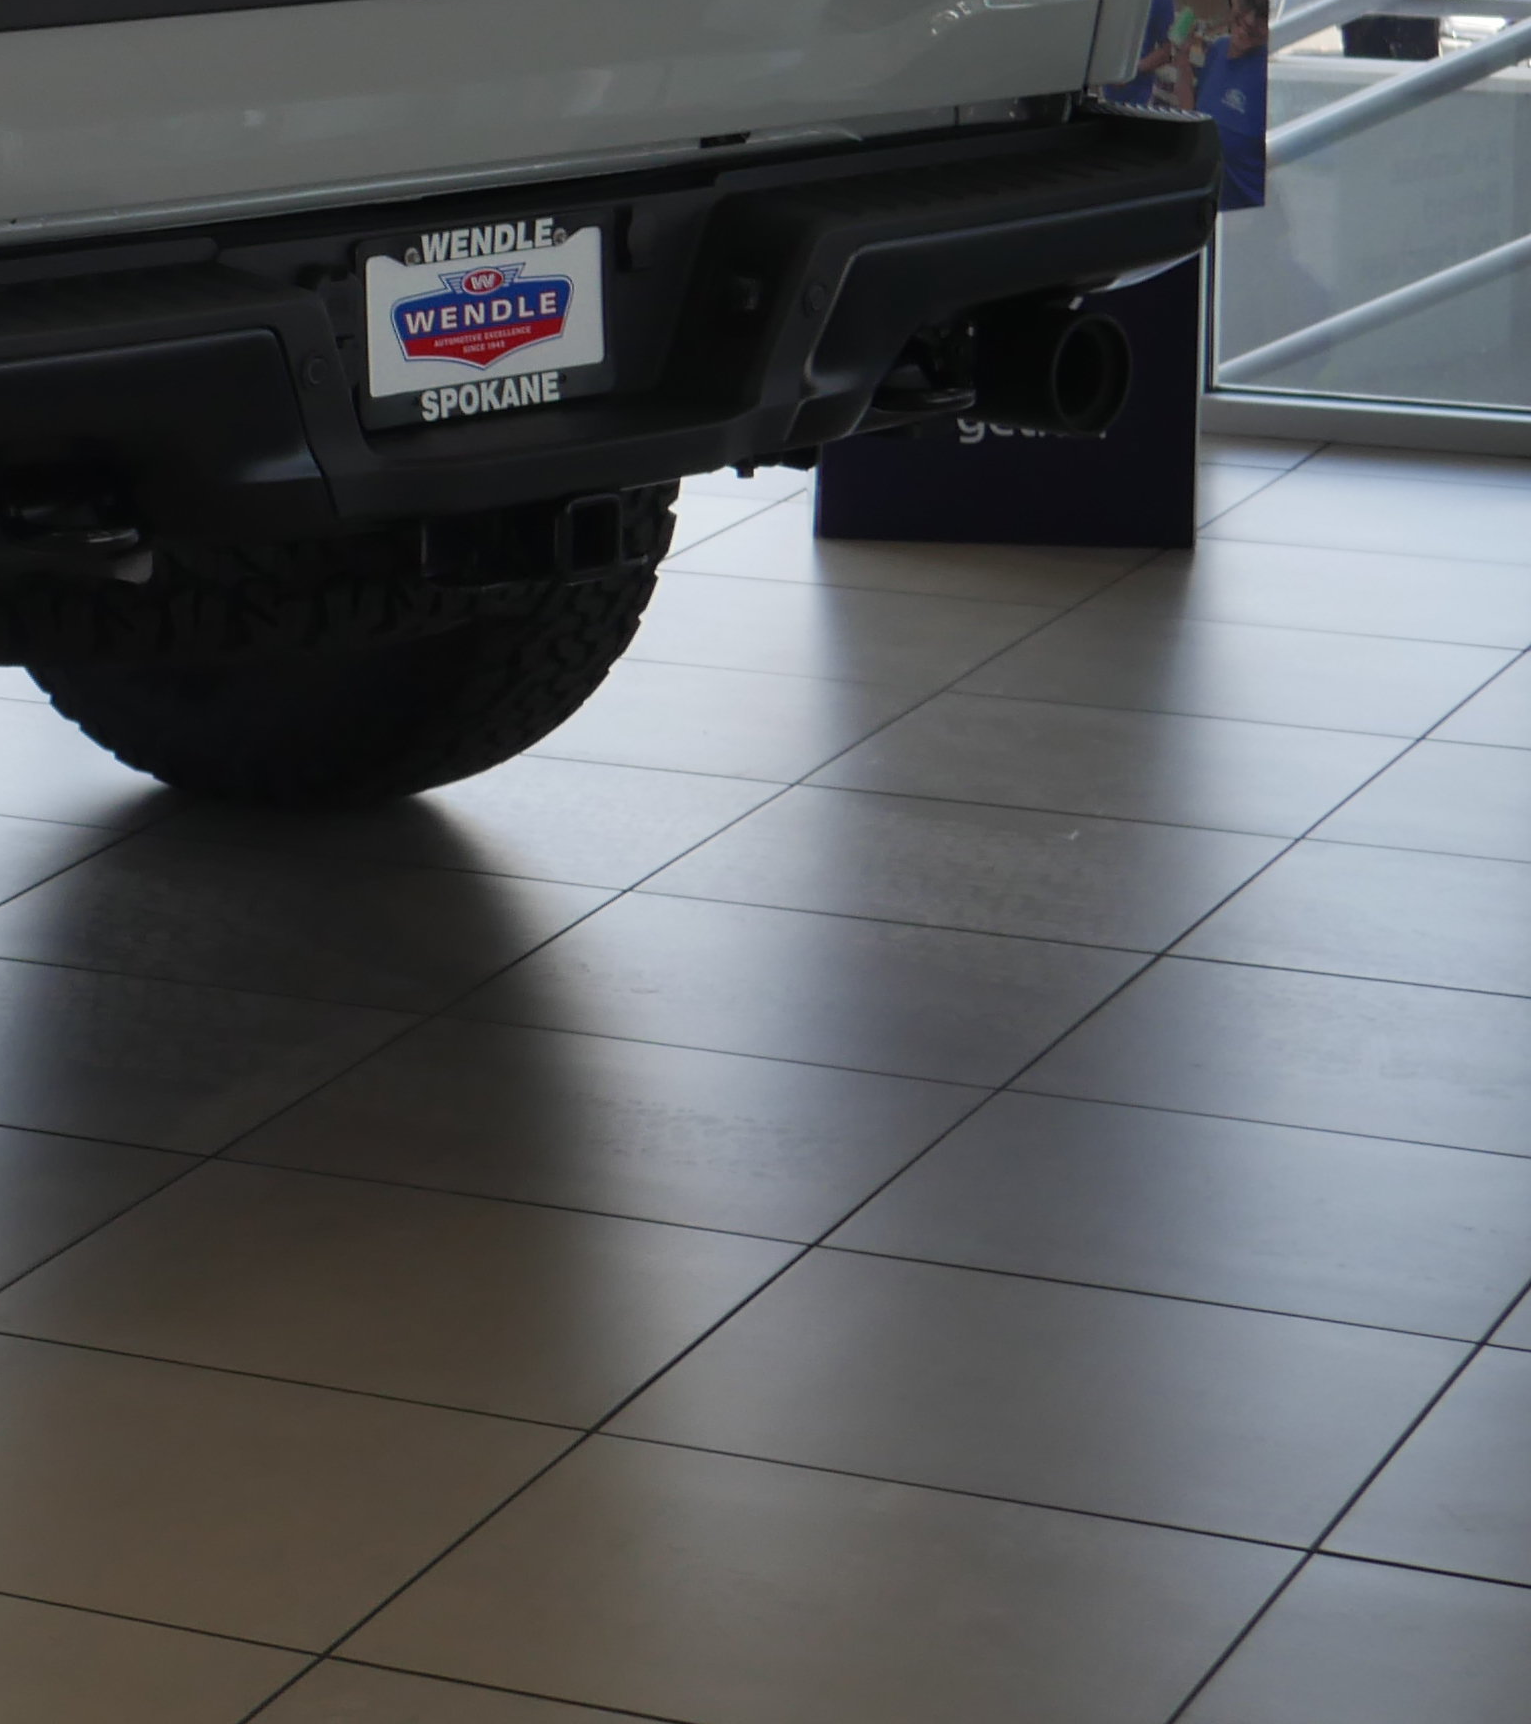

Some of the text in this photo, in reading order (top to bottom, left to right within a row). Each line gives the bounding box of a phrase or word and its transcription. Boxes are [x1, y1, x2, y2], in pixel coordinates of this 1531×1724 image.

[421, 217, 554, 263] WENDLE
[405, 292, 557, 335] WENDLE
[433, 325, 532, 348] AUTOMOTIVE EXCELLENCE
[462, 342, 485, 354] SINCE
[420, 370, 561, 422] SPOKANE
